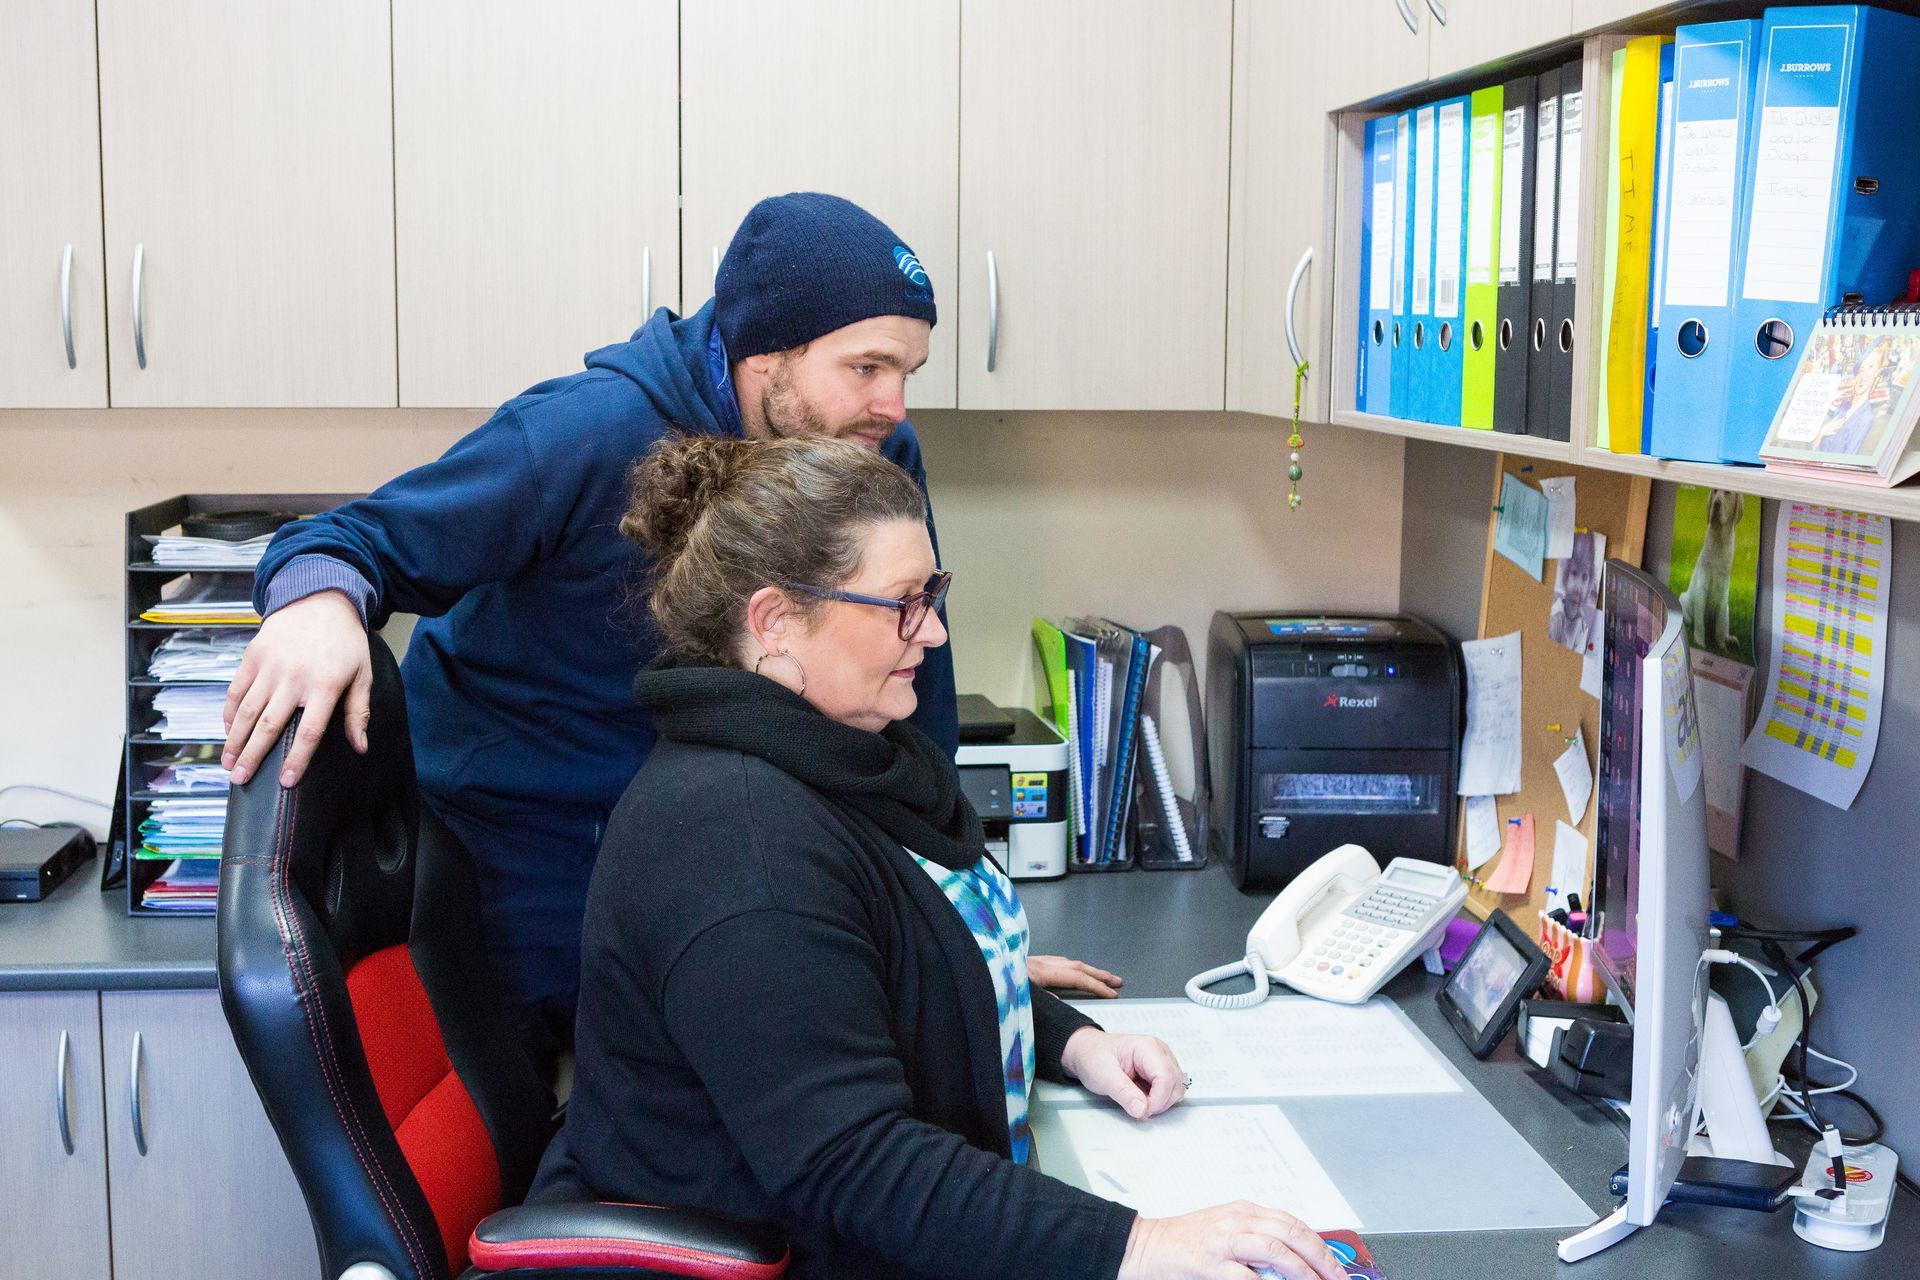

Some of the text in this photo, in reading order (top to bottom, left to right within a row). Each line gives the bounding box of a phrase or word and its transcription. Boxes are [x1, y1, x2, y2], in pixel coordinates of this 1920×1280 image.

[1780, 63, 1831, 72] J.BURROWS
[1688, 78, 1730, 88] J.BURROWS
[1621, 149, 1635, 251] TIME
[1339, 696, 1377, 708] Rexel
